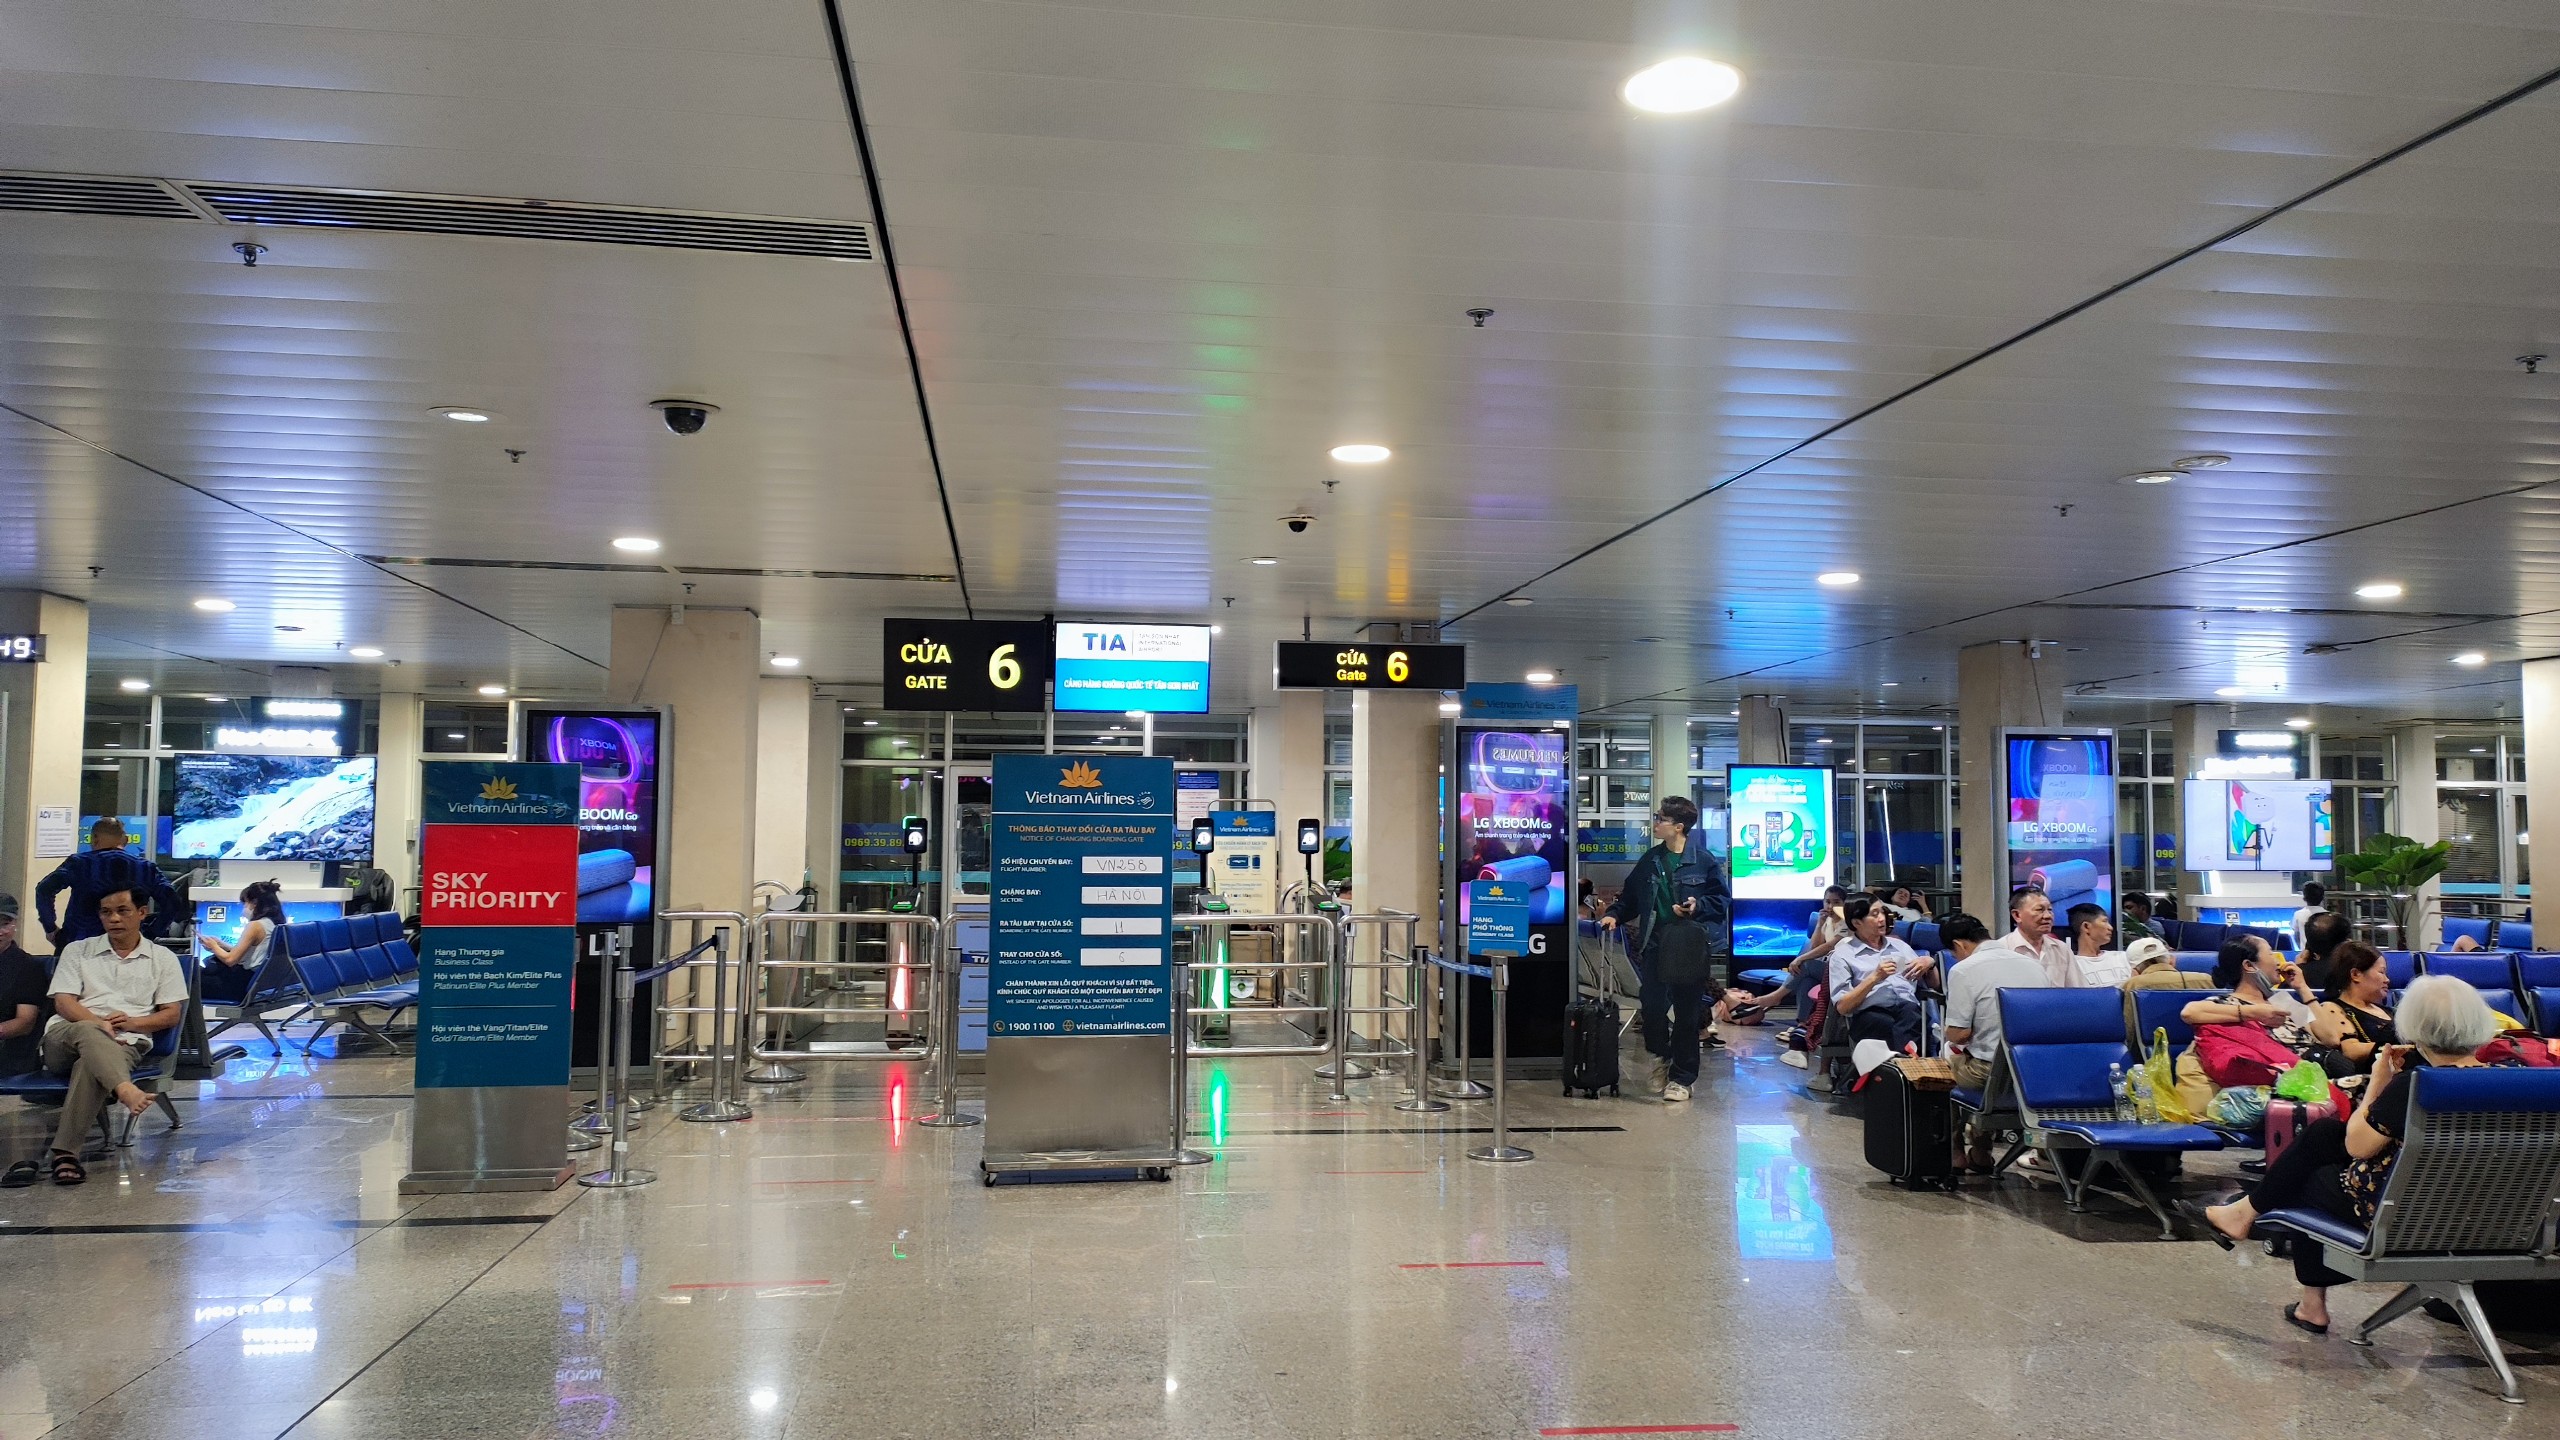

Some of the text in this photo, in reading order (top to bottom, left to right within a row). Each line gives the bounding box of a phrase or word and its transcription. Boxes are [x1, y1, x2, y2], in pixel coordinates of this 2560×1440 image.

[1082, 633, 1126, 651] TIA
[901, 637, 1022, 690] CỬA 6
[1336, 649, 1409, 682] CỬA 6
[1336, 670, 1367, 681] Gate
[905, 676, 947, 689] GATE
[1486, 700, 1555, 709] Vietnam Airlines
[580, 738, 616, 750] XBOOM
[1025, 791, 1083, 804] Vietnam
[1084, 792, 1135, 805] Airlines
[448, 802, 548, 814] Vietnam Airlines
[625, 812, 638, 820] Go
[1008, 825, 1037, 833] THÔNG
[1039, 825, 1055, 833] BÁO
[1079, 824, 1093, 833] ĐỔI
[1095, 825, 1111, 833] CỬA
[1125, 826, 1140, 834] TÀU
[1474, 818, 1552, 829] LG XBOOM Go
[2024, 822, 2038, 832] LG
[2042, 822, 2086, 832] XBOOM
[1001, 857, 1010, 865] SỐ
[1011, 858, 1028, 866] HIỆU
[1029, 857, 1057, 865] CHUYẾN
[1097, 859, 1147, 871] VN258
[432, 872, 488, 889] SKY
[1000, 888, 1025, 896] CHẶNG
[1098, 888, 1117, 901] HÀ
[431, 891, 561, 909] PRIORITY
[1115, 921, 1124, 933] 11
[434, 948, 505, 957] Hạng Thương gia
[1119, 951, 1125, 962] 6
[434, 973, 447, 981] Hội
[484, 972, 504, 980] Bạch
[506, 971, 542, 979] Kim/Elite
[544, 971, 562, 979] Plus
[431, 1024, 548, 1033] Hội viên thẻ Vàng/Titan/Elite
[1008, 1021, 1166, 1031] 1900 1100 vietnamairlines.com
[431, 1034, 504, 1042] Gold/Titanium/Elite
